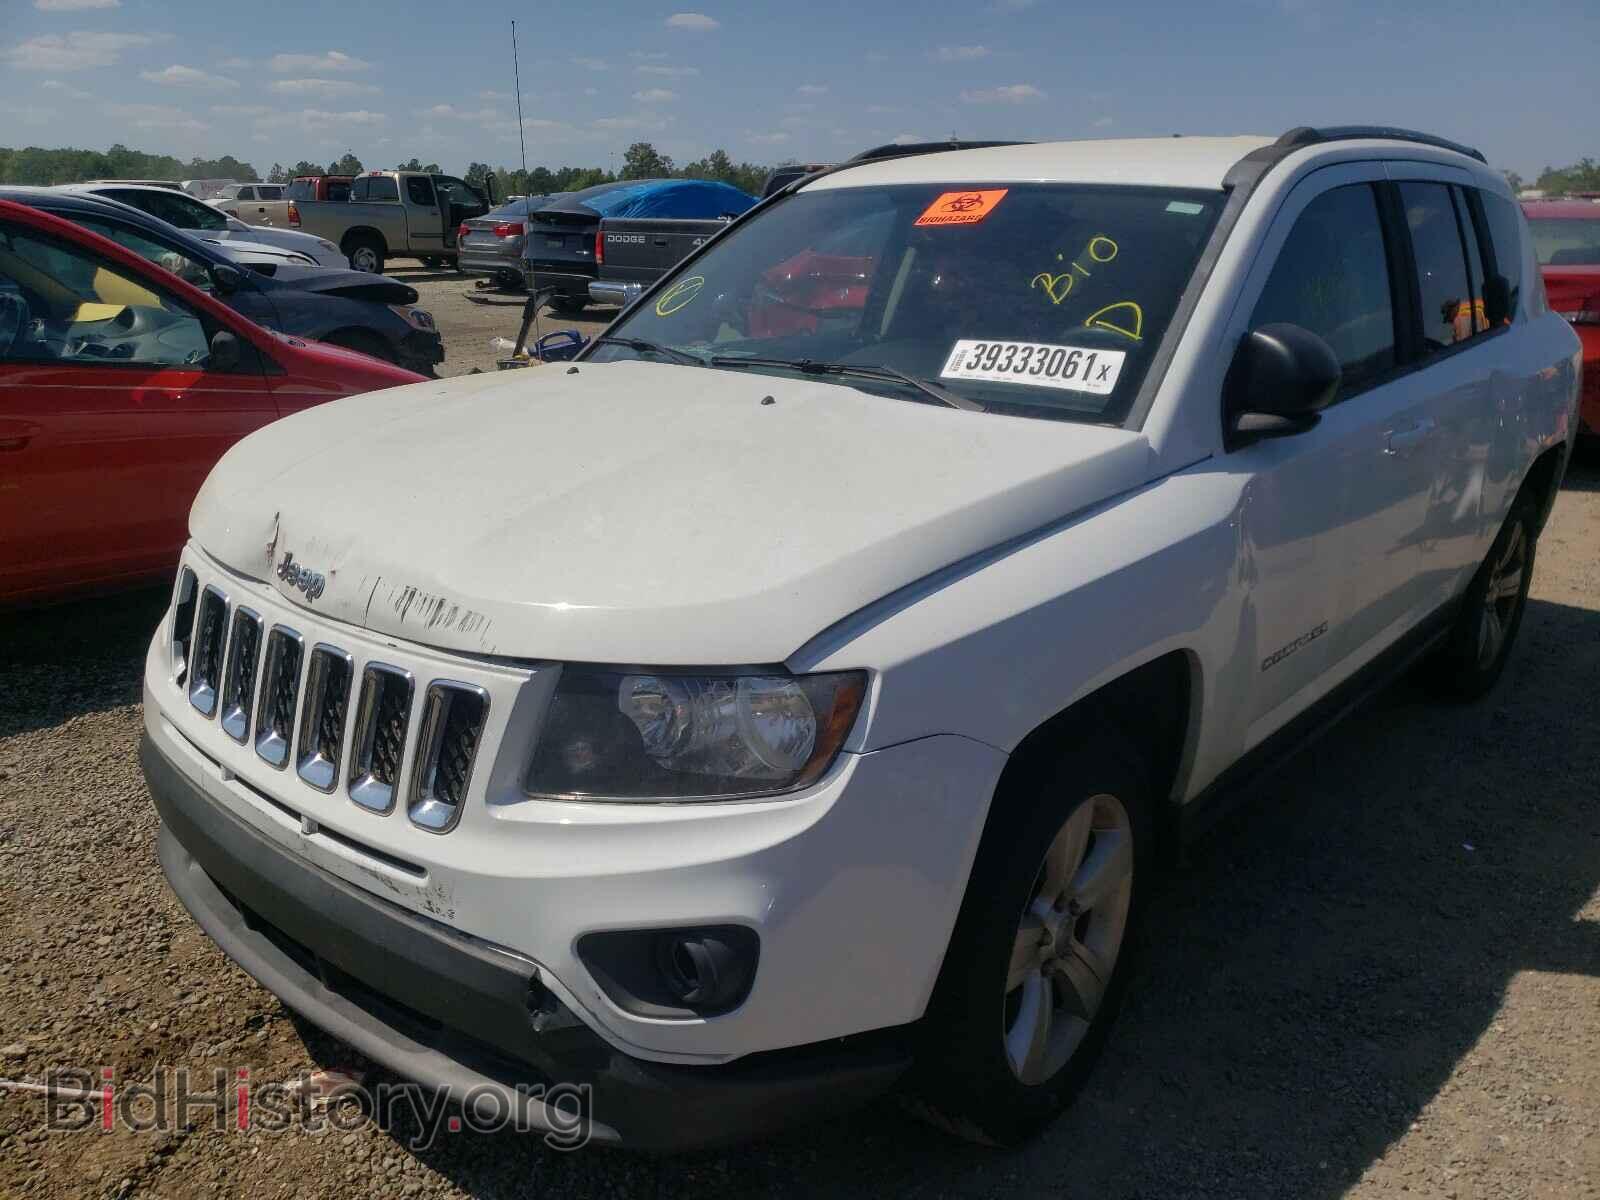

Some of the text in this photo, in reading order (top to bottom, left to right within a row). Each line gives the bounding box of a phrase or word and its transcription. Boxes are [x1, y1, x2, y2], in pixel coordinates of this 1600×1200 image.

[607, 234, 646, 244] DODGE
[965, 343, 1098, 382] 39333061
[277, 551, 326, 603] Jeep
